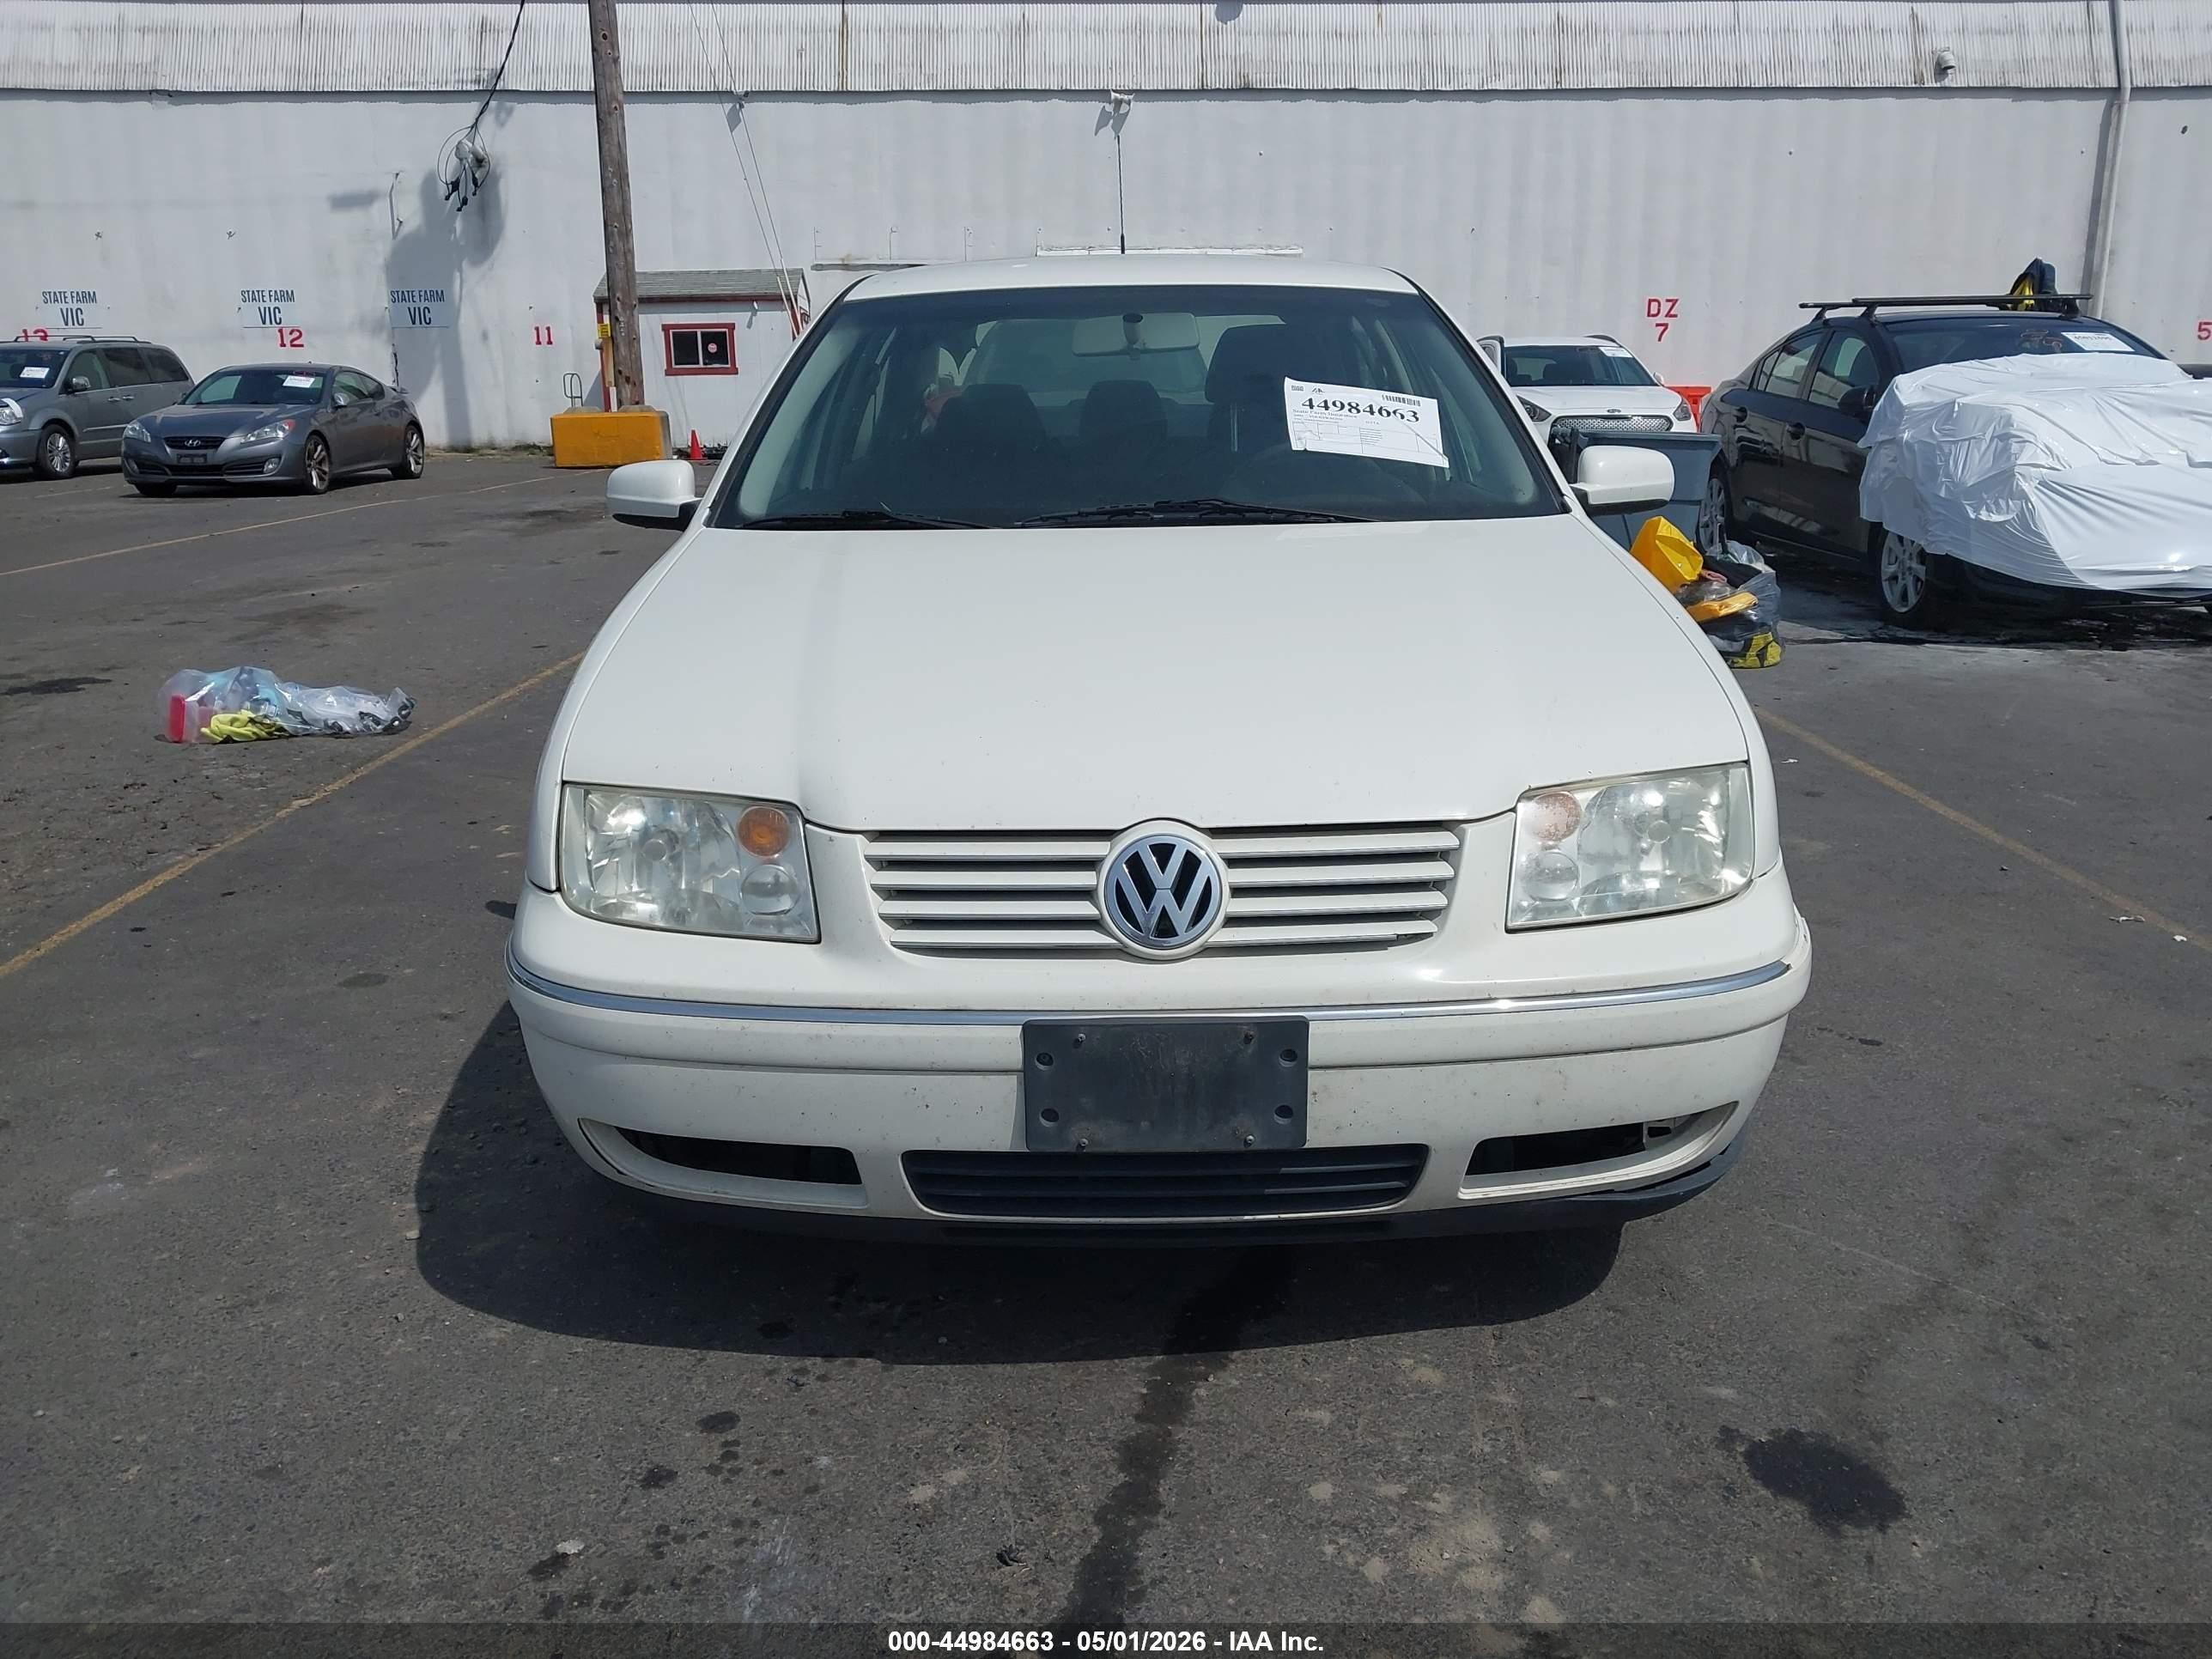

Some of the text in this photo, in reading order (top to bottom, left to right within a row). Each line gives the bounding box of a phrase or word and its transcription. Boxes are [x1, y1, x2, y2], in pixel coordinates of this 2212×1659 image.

[42, 291, 97, 304] STATE FARM
[240, 289, 295, 302] STATE FARM
[391, 289, 445, 303] STATE FARM
[60, 307, 84, 326] VIC
[258, 306, 282, 325] VIC
[407, 306, 432, 325] VIC
[1647, 298, 1679, 318] DZ
[277, 329, 305, 347] 12
[534, 325, 553, 345] 11
[1655, 323, 1669, 342] 7
[1301, 397, 1420, 423] 44984663
